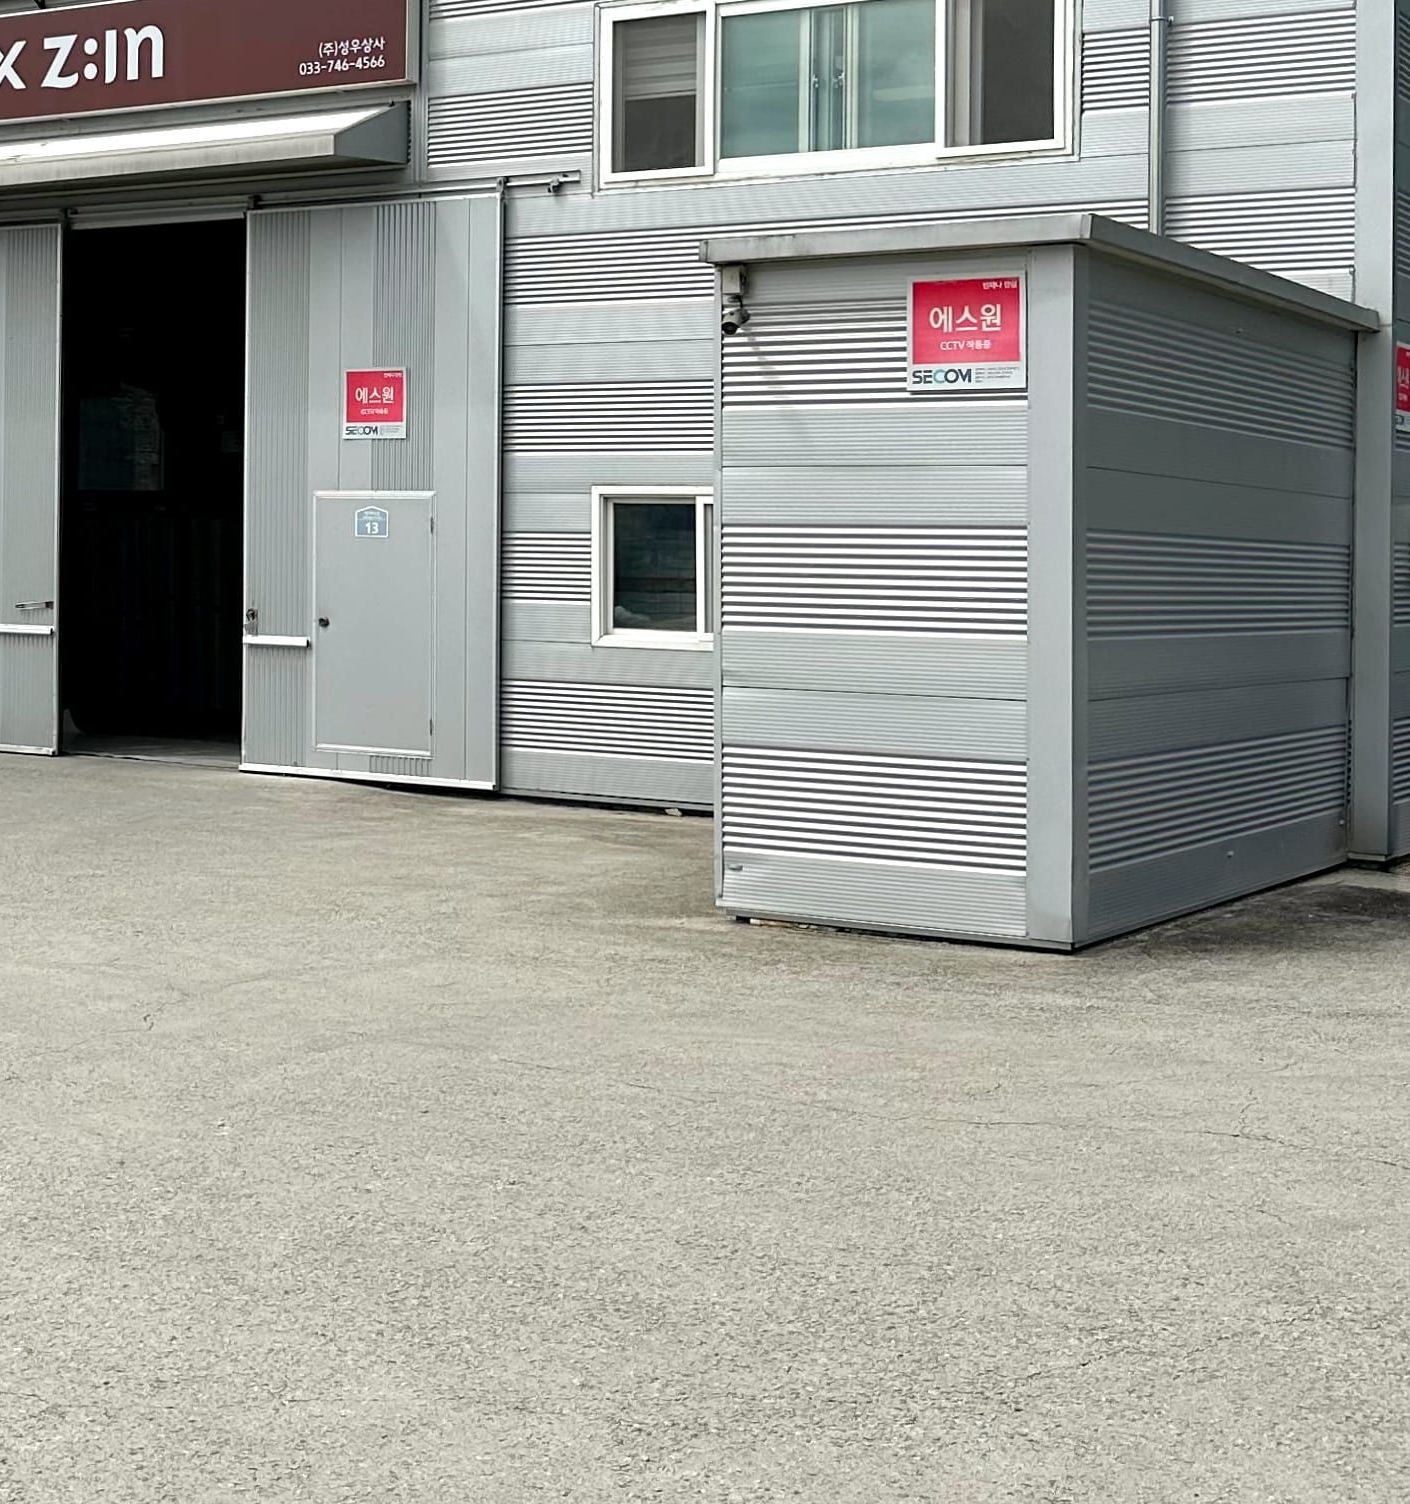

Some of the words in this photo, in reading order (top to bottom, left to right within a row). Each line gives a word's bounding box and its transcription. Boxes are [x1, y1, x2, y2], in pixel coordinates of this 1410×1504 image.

[319, 36, 385, 58] (주)성우상사
[299, 55, 385, 75] 033-746-4566
[929, 304, 1001, 333] 에스원
[940, 341, 965, 350] CCTV
[912, 368, 972, 384] SECOM
[355, 386, 394, 404] 에스원
[365, 522, 379, 534] 13
